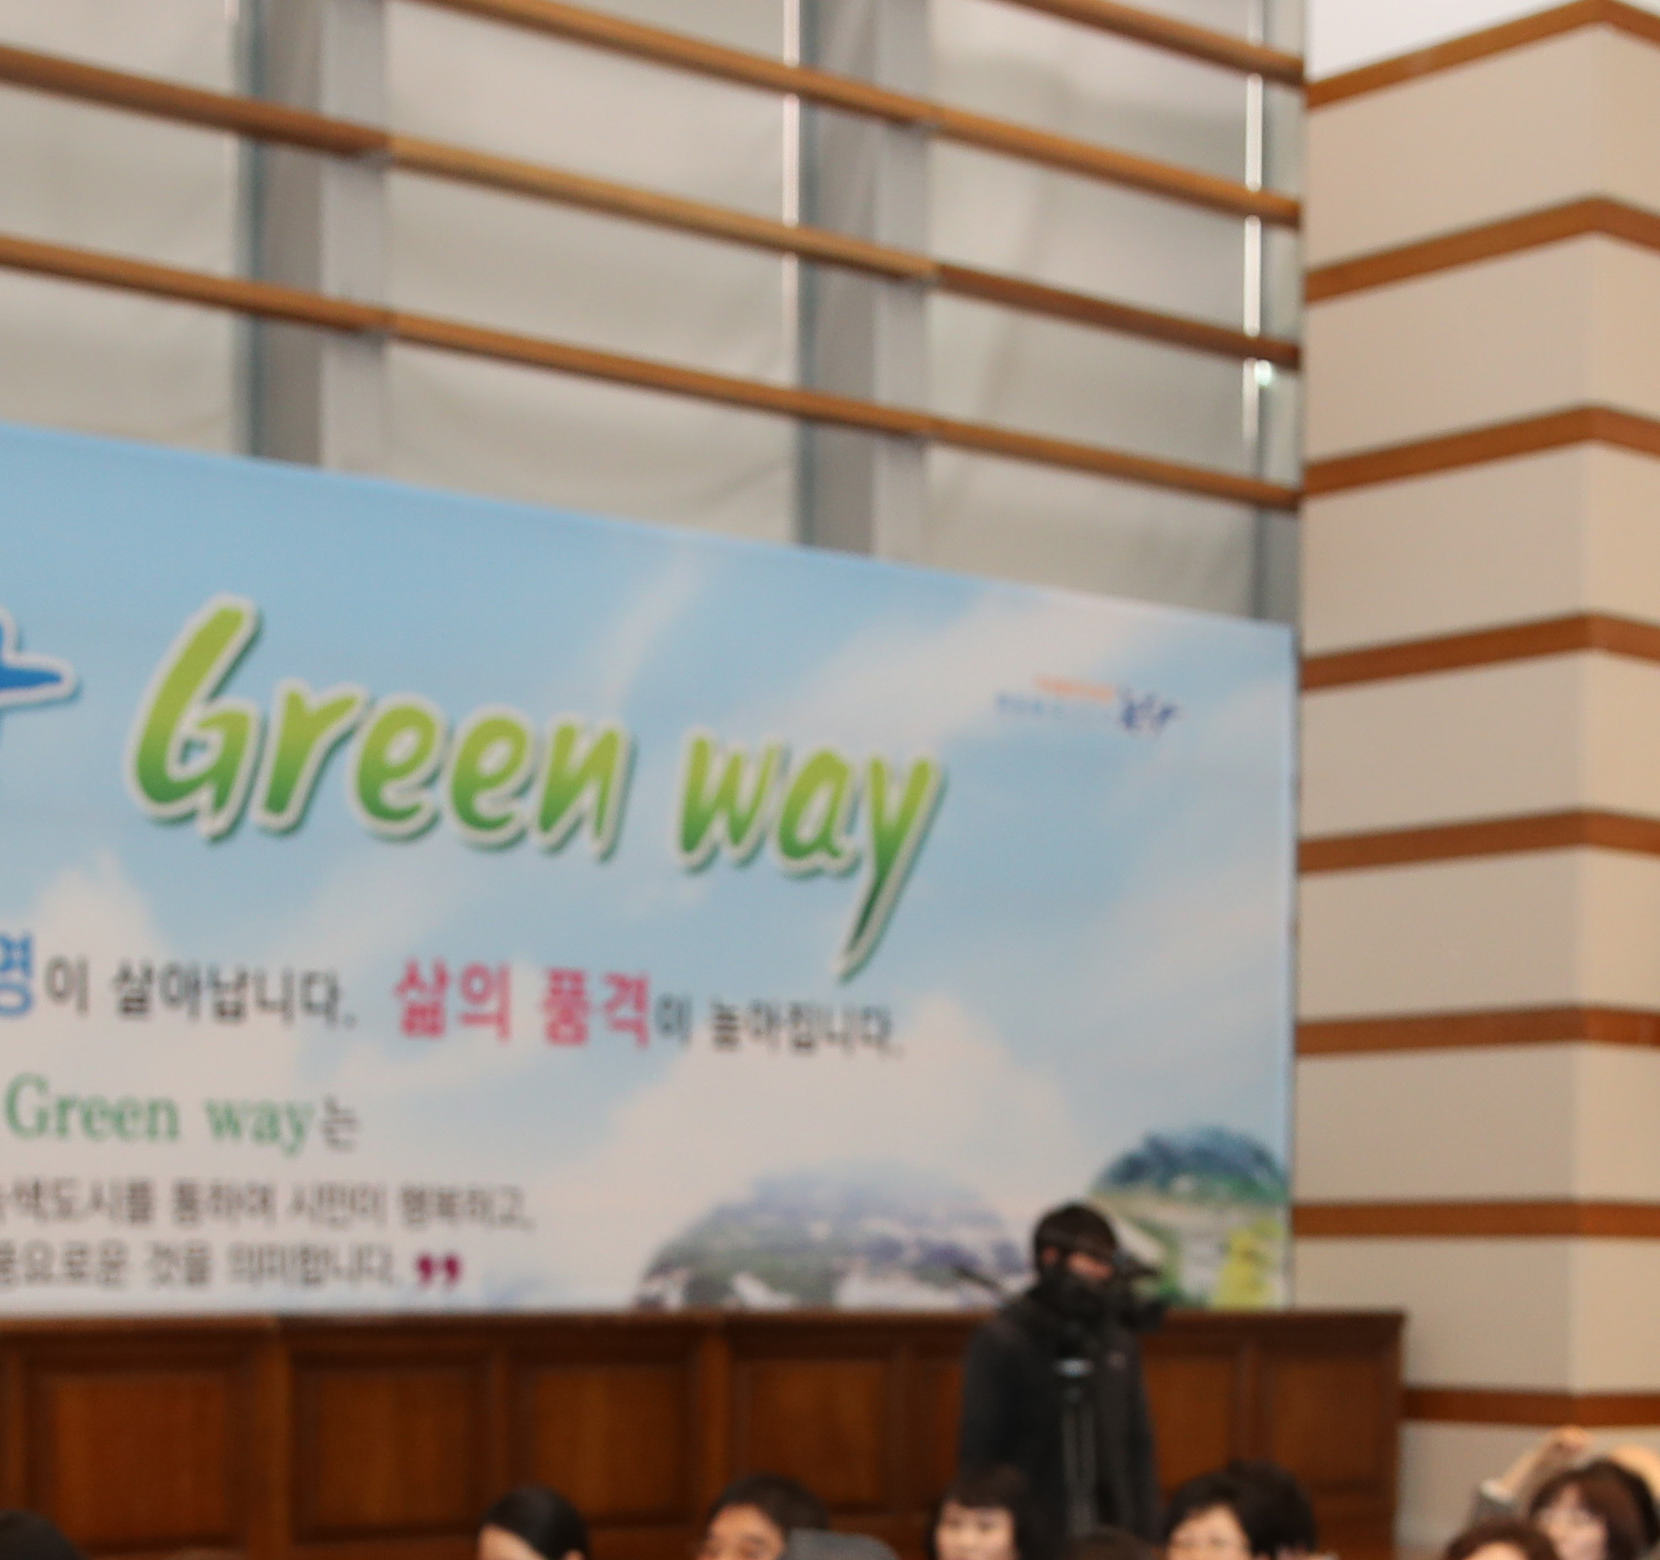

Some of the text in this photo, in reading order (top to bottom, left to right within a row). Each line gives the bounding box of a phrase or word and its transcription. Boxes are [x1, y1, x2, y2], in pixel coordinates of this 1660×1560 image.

[127, 592, 630, 859] Green
[675, 722, 945, 977] way
[112, 958, 357, 1029] 살아납니다.
[394, 957, 512, 1044] 삶의
[541, 966, 693, 1050] 품격이
[710, 994, 904, 1057] 높아집니다.
[5, 1073, 180, 1142] Green
[205, 1090, 361, 1156] way는
